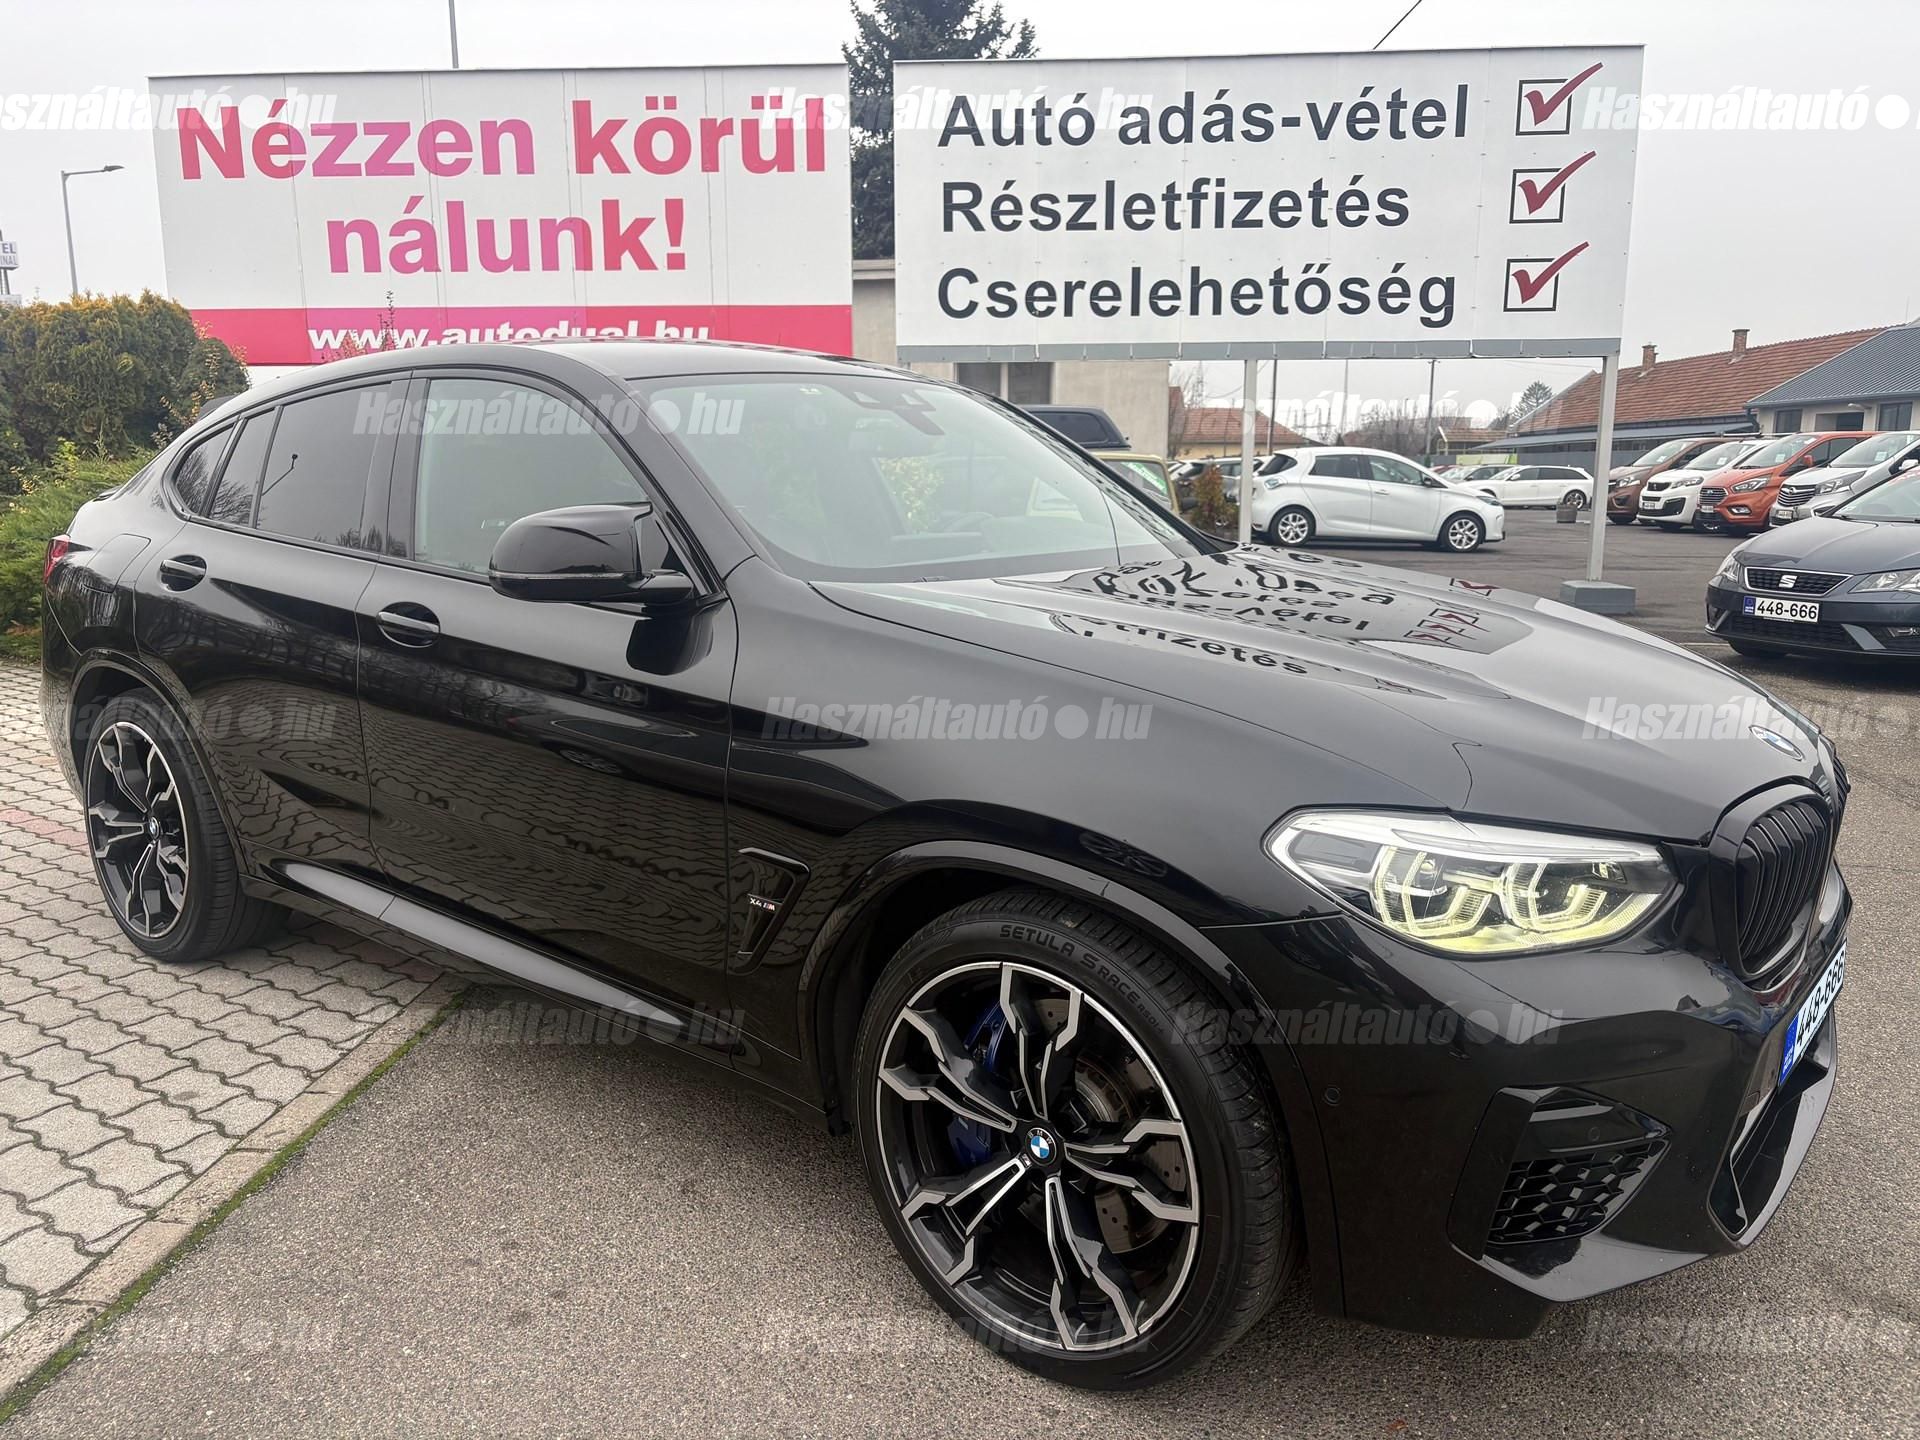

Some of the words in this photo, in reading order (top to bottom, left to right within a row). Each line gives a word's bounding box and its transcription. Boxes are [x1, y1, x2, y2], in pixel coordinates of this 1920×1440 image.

[178, 100, 535, 180] Nézzen
[572, 95, 826, 175] körül
[937, 92, 1096, 147] Autó
[1118, 85, 1469, 146] adás-vétel
[327, 196, 686, 274] nálunk!
[943, 174, 1410, 232] Részletfizetés
[938, 262, 1456, 329] Cserelehetőség
[307, 320, 709, 350] www.autodlhu
[1756, 600, 1818, 620] 448-666
[1000, 924, 1076, 958] SETULA
[1100, 965, 1142, 1003] RACE
[1796, 949, 1846, 1047] 448-666
